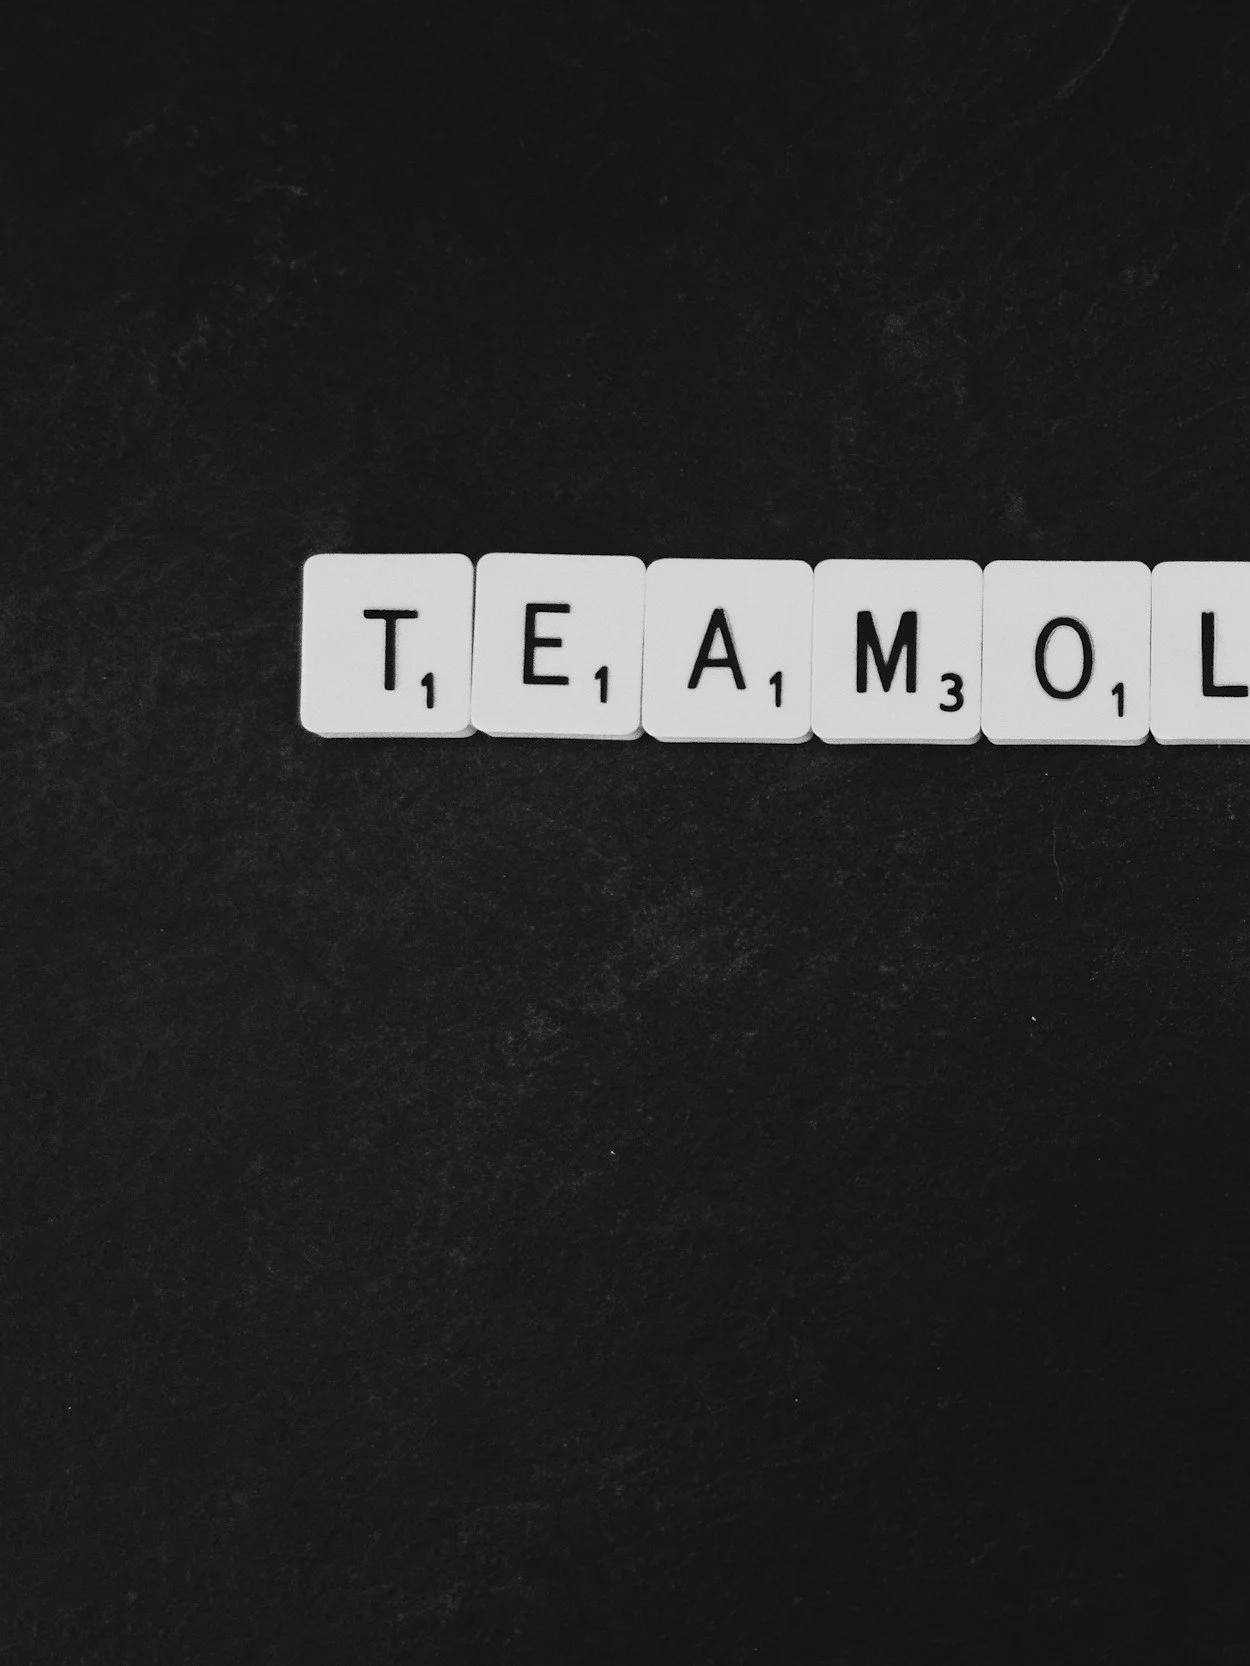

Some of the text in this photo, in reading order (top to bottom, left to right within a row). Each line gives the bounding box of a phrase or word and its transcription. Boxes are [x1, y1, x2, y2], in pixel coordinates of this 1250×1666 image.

[420, 672, 435, 710] 1
[594, 665, 609, 704] 1
[769, 670, 783, 708] 1
[939, 672, 965, 713] 3
[1111, 682, 1125, 718] 1
